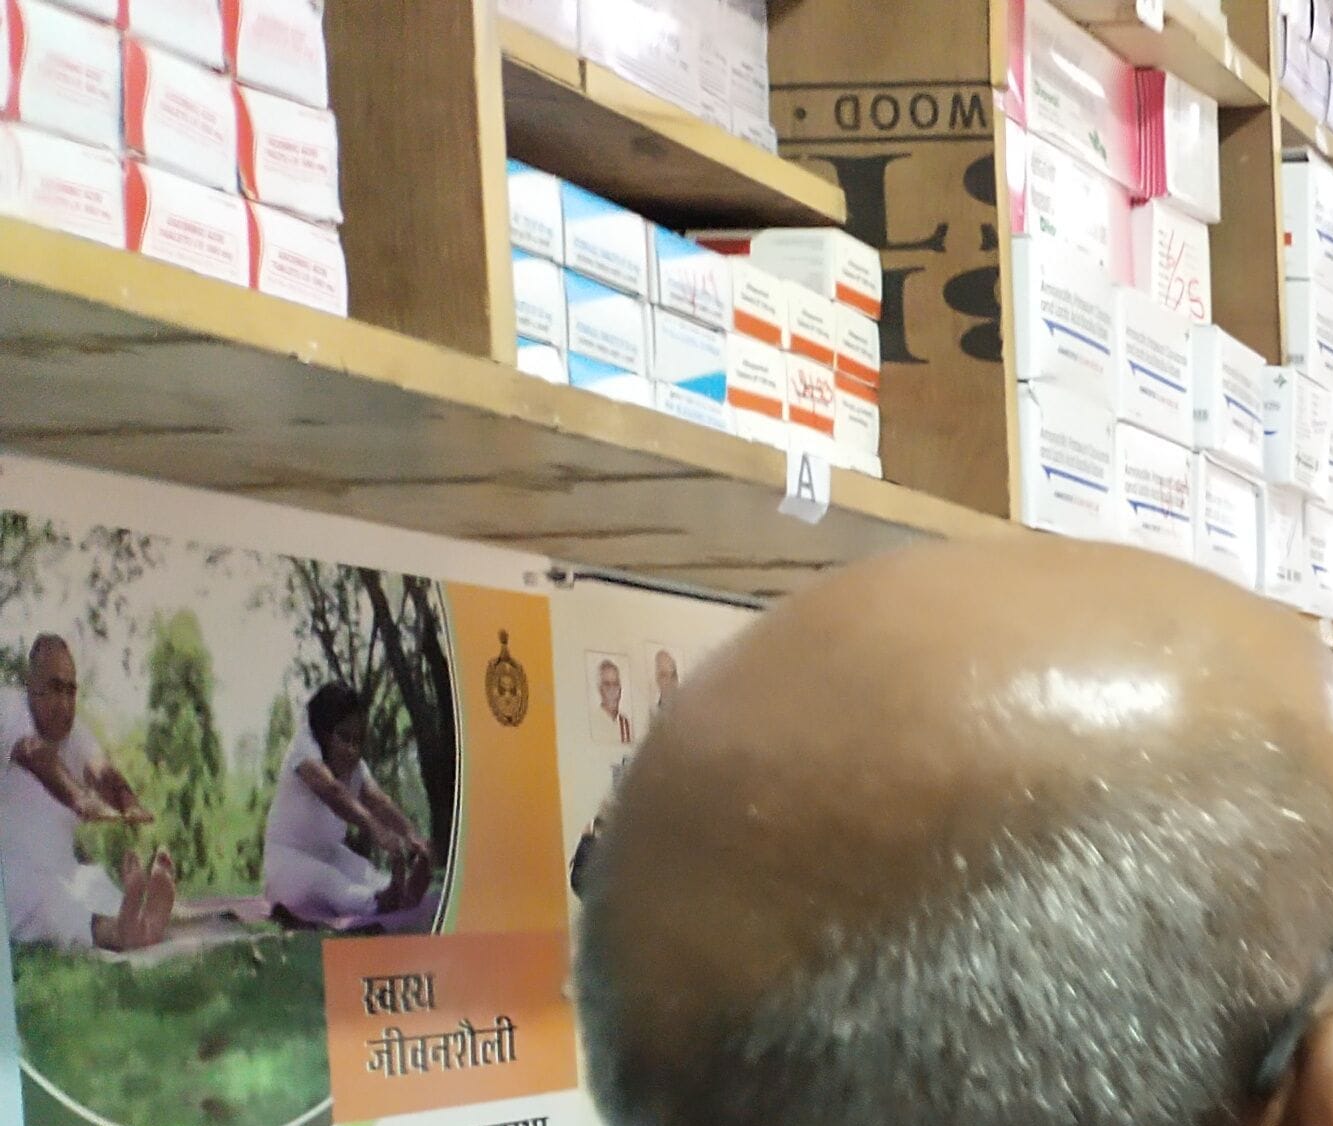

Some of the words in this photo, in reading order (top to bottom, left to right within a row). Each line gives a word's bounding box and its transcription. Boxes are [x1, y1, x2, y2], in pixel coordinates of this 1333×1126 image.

[834, 92, 987, 131] WOOD
[796, 452, 817, 502] A
[361, 973, 436, 1015] स्वस्थ
[365, 1014, 518, 1078] जीवनशैली
